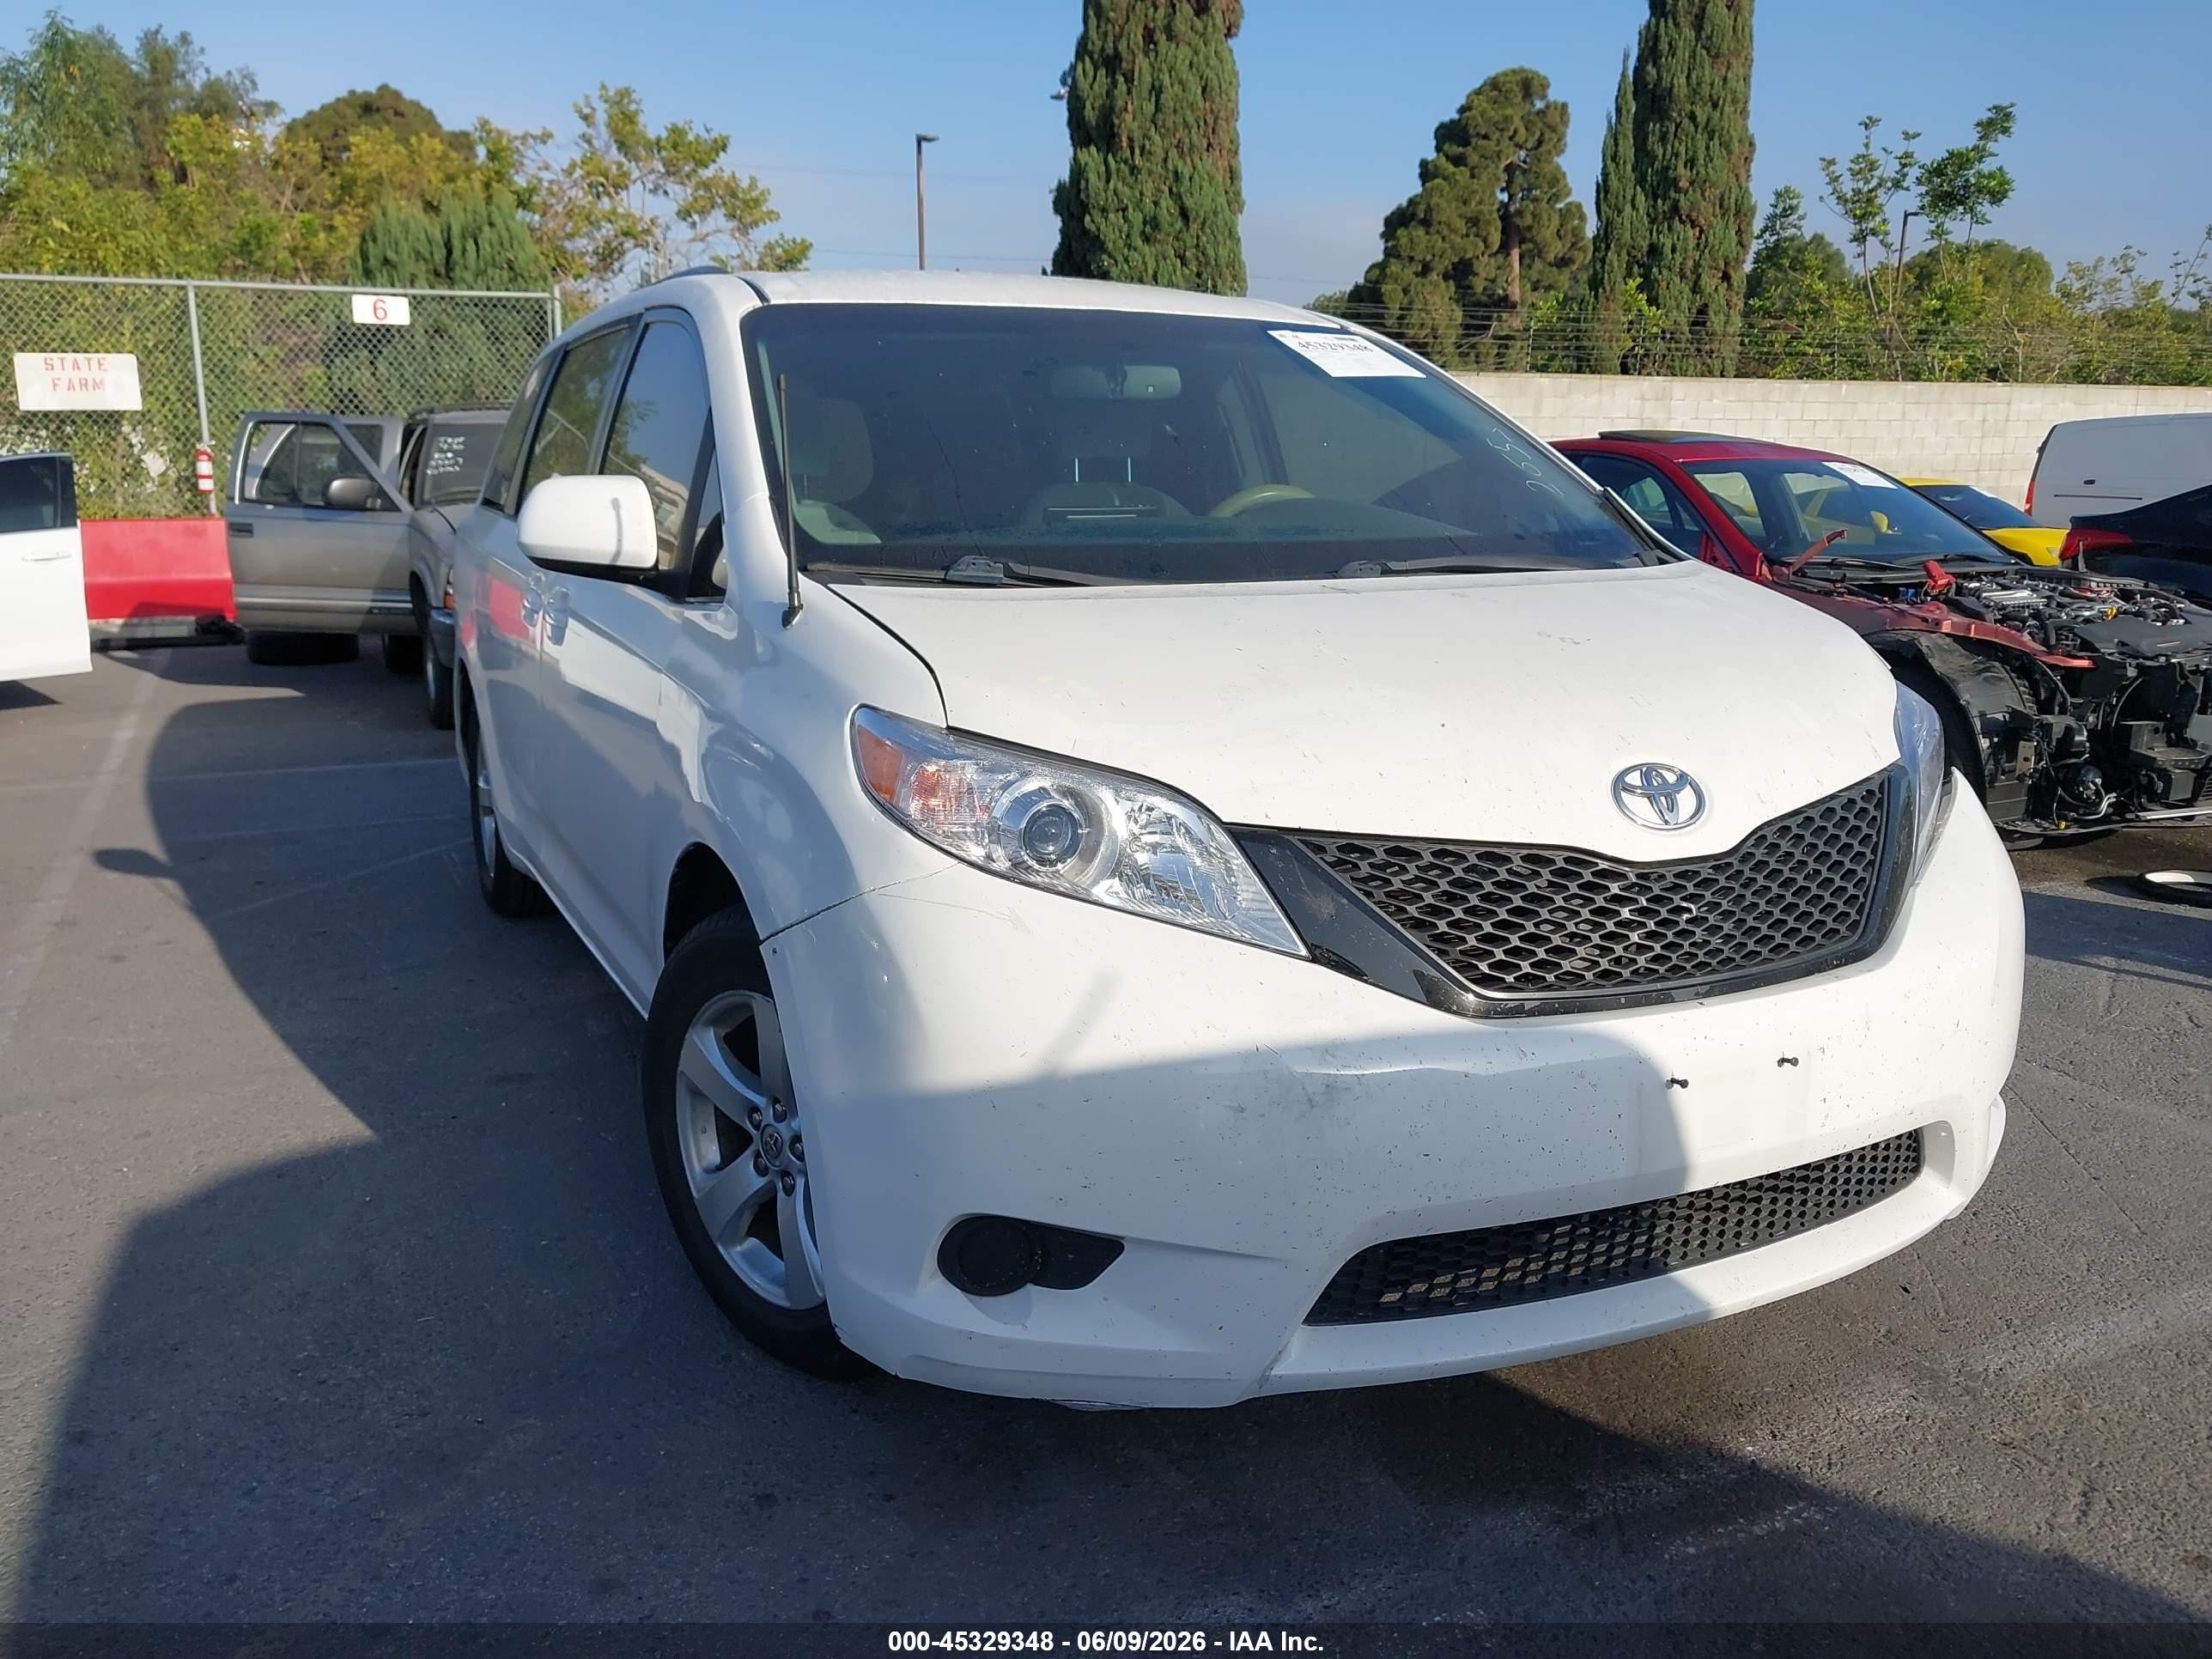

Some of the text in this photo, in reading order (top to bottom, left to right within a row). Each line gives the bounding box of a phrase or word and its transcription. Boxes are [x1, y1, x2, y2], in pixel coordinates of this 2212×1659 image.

[373, 298, 388, 320] 6
[44, 356, 108, 372] STATE
[52, 377, 106, 392] FARM
